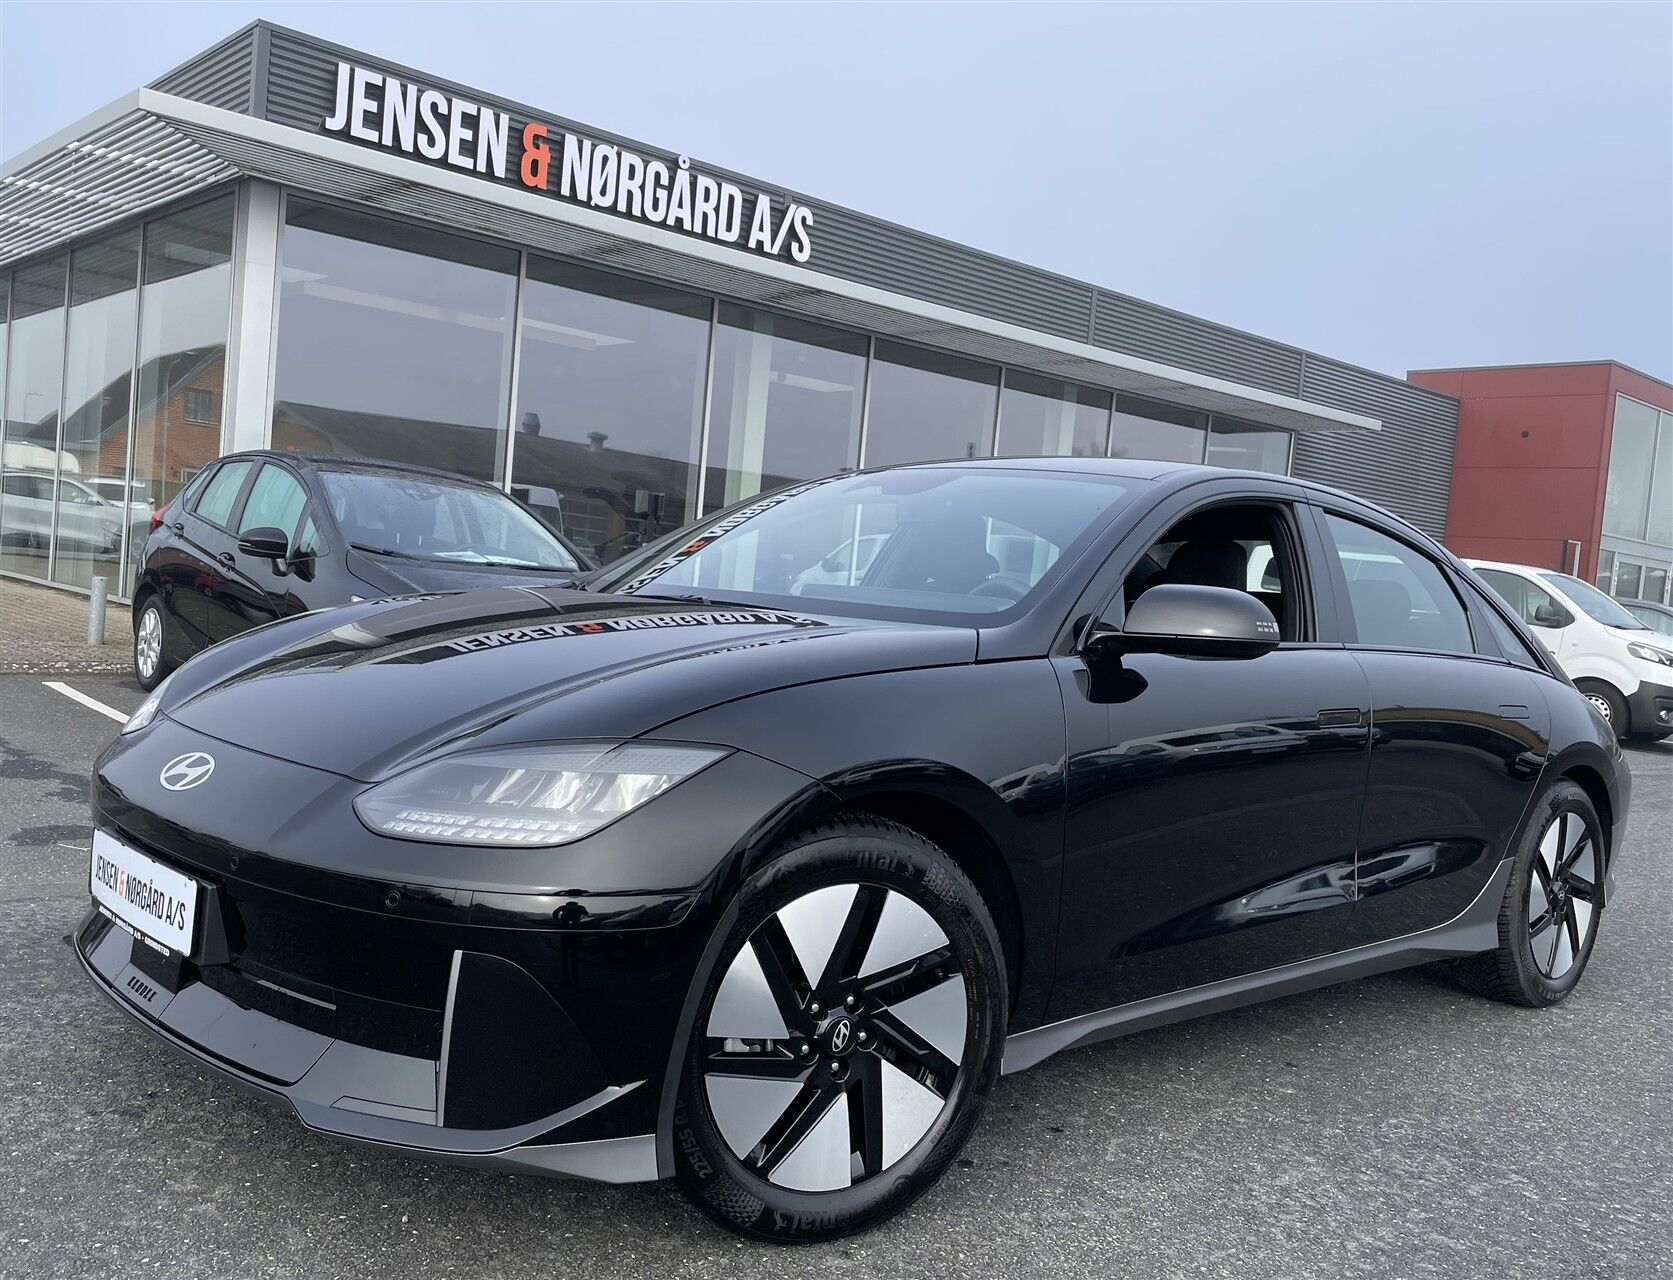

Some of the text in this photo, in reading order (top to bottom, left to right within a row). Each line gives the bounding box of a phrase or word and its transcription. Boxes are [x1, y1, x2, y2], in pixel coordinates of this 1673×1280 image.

[324, 61, 815, 263] JENSEN & NØRGÅRD A/S
[95, 854, 120, 892] JENSEN
[118, 869, 126, 897] &
[124, 872, 165, 920] NØRGÅRD
[165, 895, 186, 931] A/S
